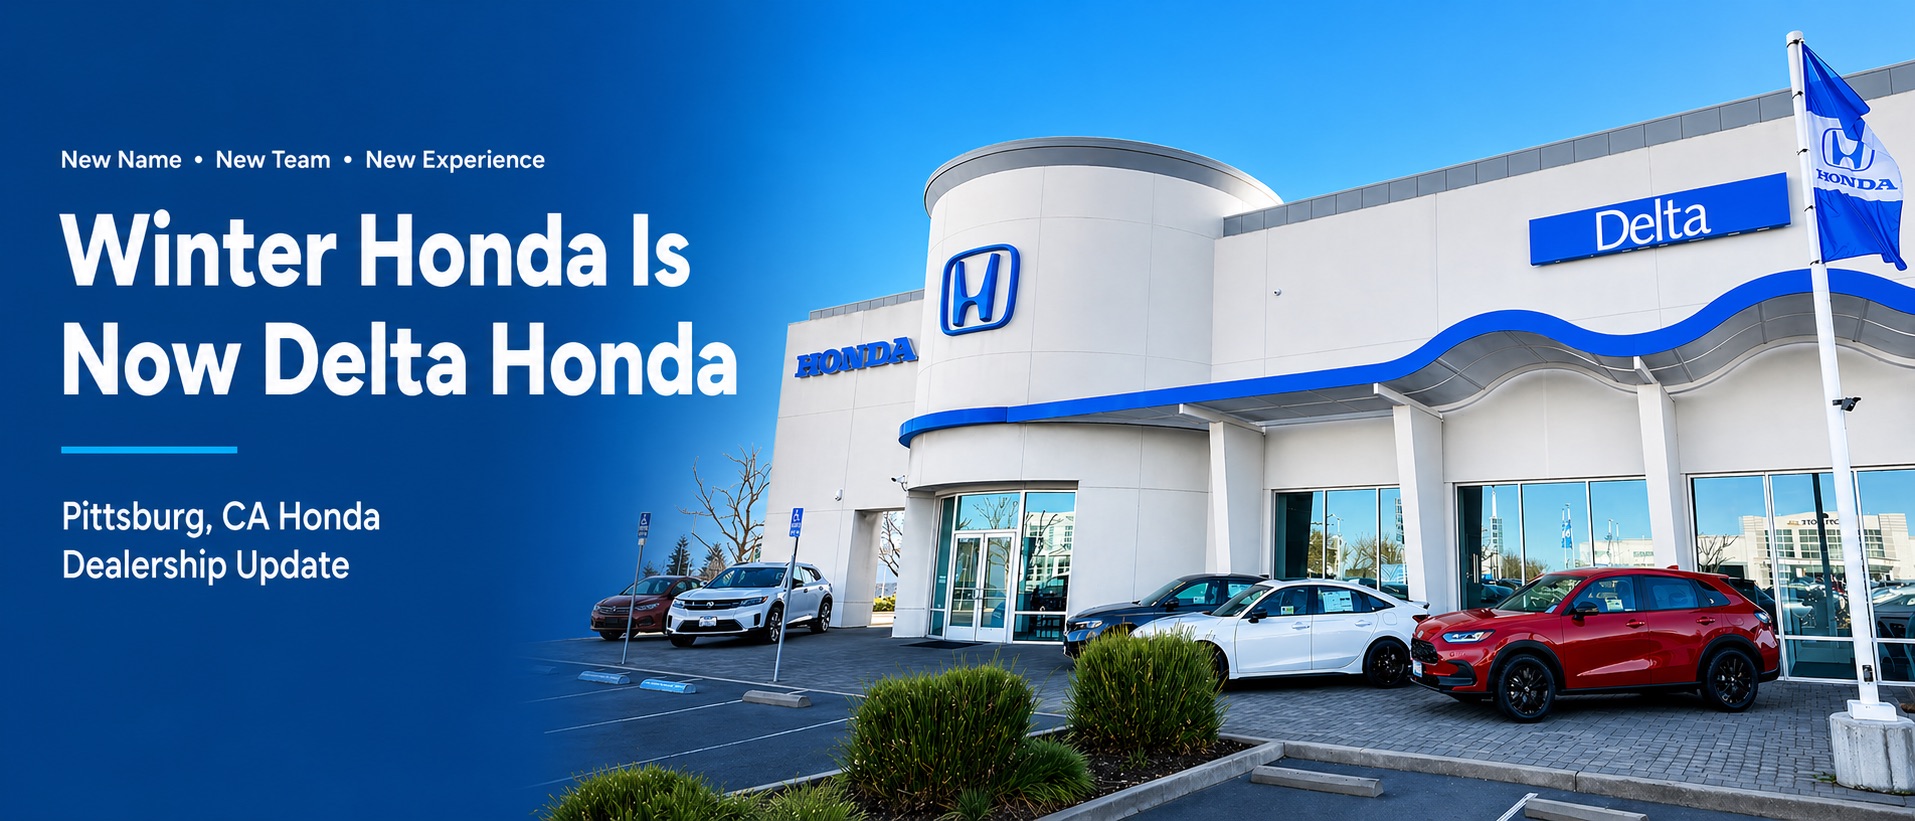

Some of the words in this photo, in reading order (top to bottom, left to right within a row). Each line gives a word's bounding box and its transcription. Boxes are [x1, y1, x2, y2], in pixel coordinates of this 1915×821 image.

[1816, 168, 1898, 191] HONDA
[1595, 198, 1711, 251] Delta
[794, 336, 918, 378] HONDA
